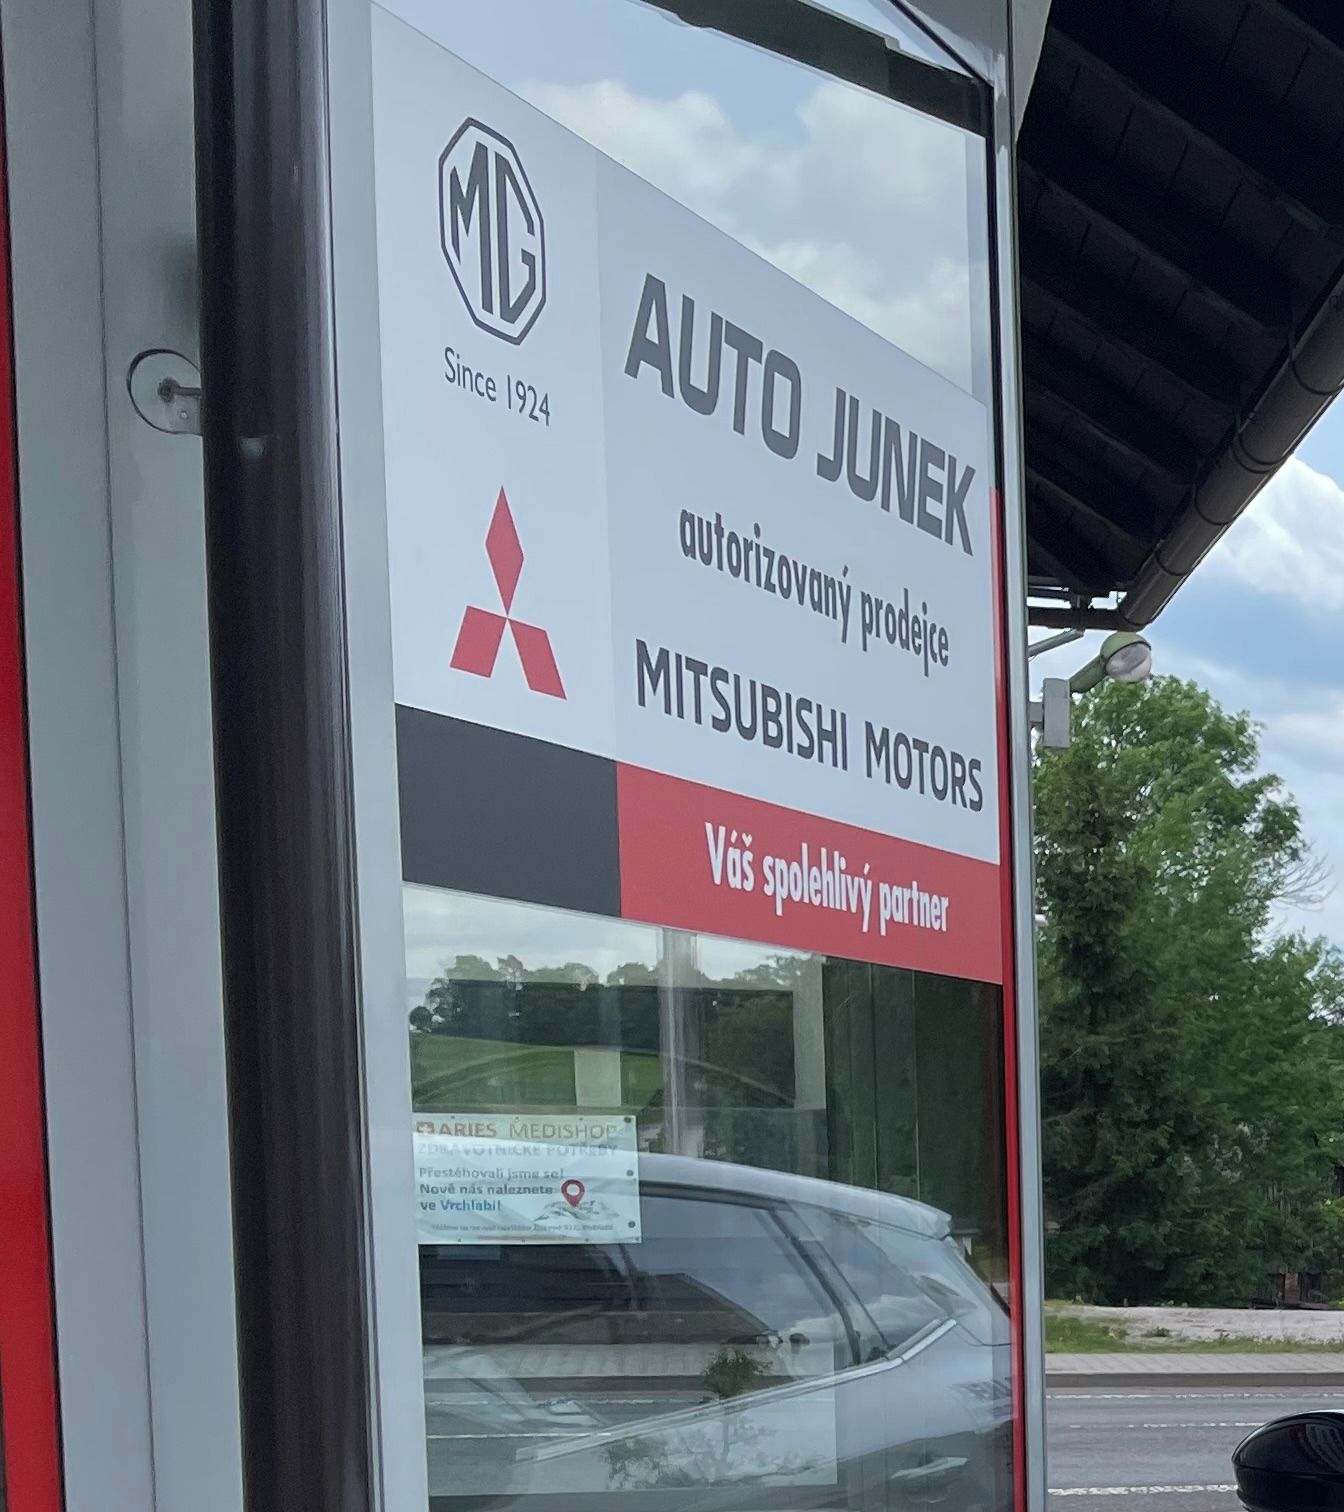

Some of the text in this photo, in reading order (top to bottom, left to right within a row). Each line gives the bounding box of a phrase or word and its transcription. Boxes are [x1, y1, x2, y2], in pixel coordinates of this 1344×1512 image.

[449, 140, 537, 324] MG
[444, 346, 551, 427] Since 1924
[624, 272, 976, 556] AUTO JUNEK
[679, 508, 949, 678] autorizovaný prodejce
[635, 638, 984, 812] MITSUBISHI MOTORS
[704, 821, 950, 937] Váš spolehlivý partner
[438, 1122, 617, 1140] ARIES MEDISHOP
[459, 1183, 484, 1195] nás
[486, 1183, 553, 1195] naleznete
[420, 1202, 437, 1211] ve
